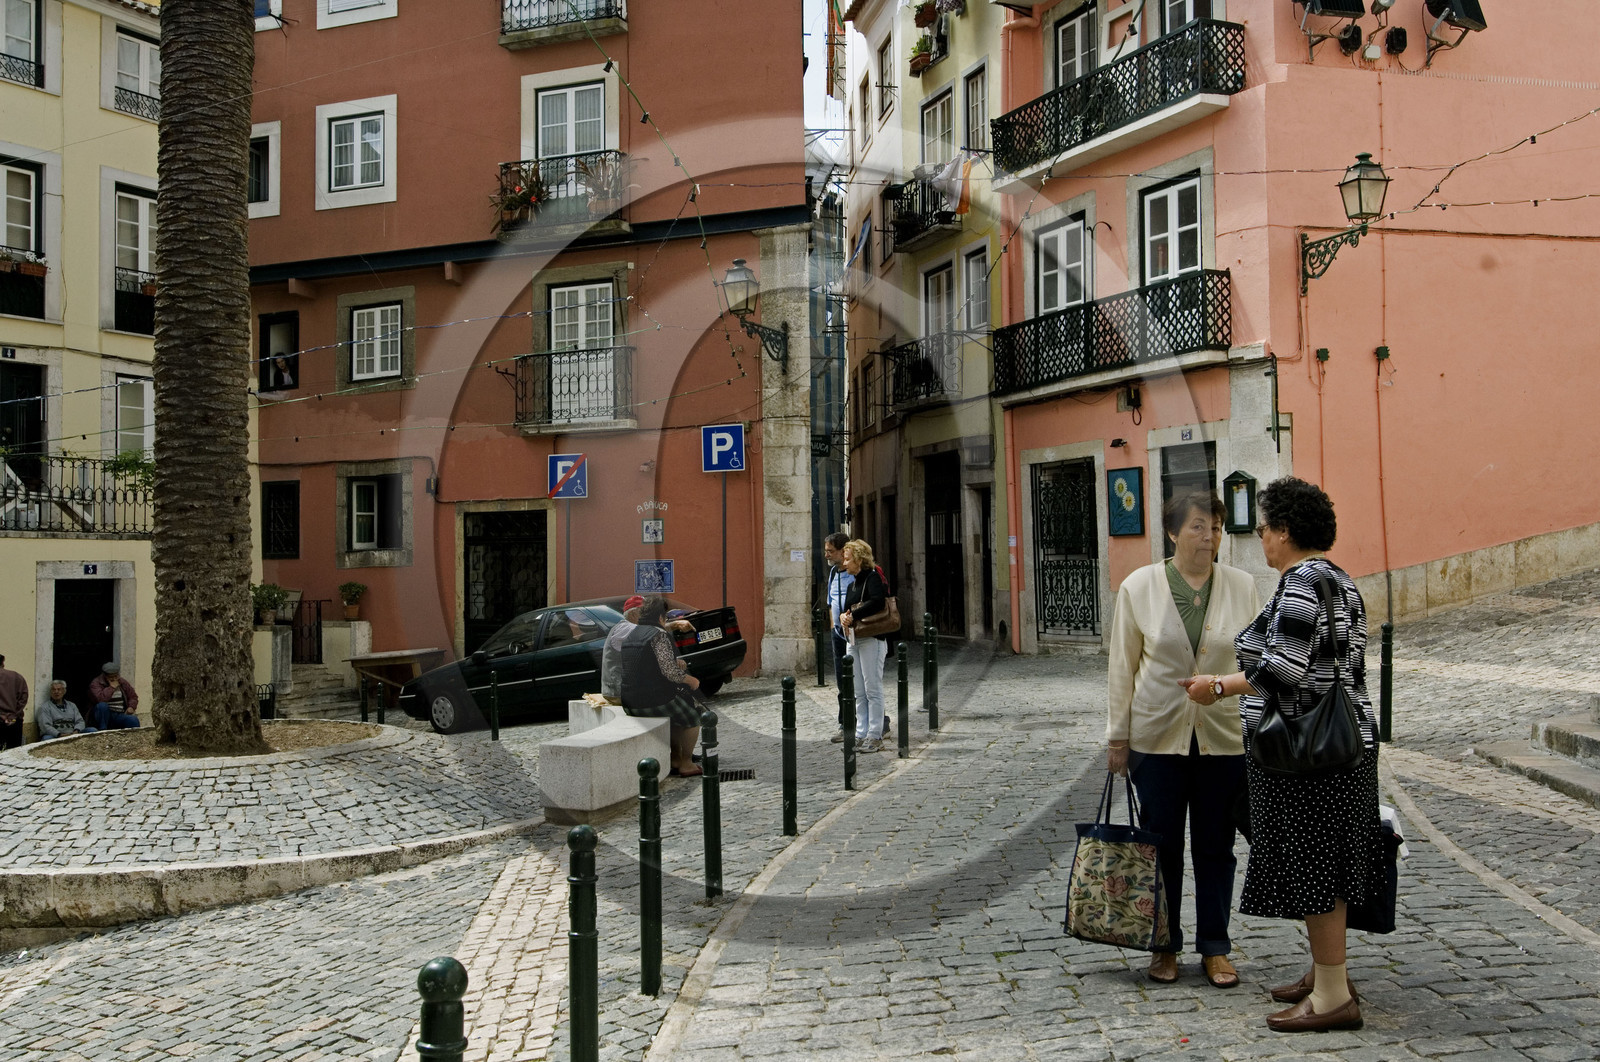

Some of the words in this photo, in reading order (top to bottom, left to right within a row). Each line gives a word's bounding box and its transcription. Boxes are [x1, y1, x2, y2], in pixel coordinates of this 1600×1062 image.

[712, 433, 734, 465] P
[557, 460, 578, 492] P
[637, 505, 644, 514] A
